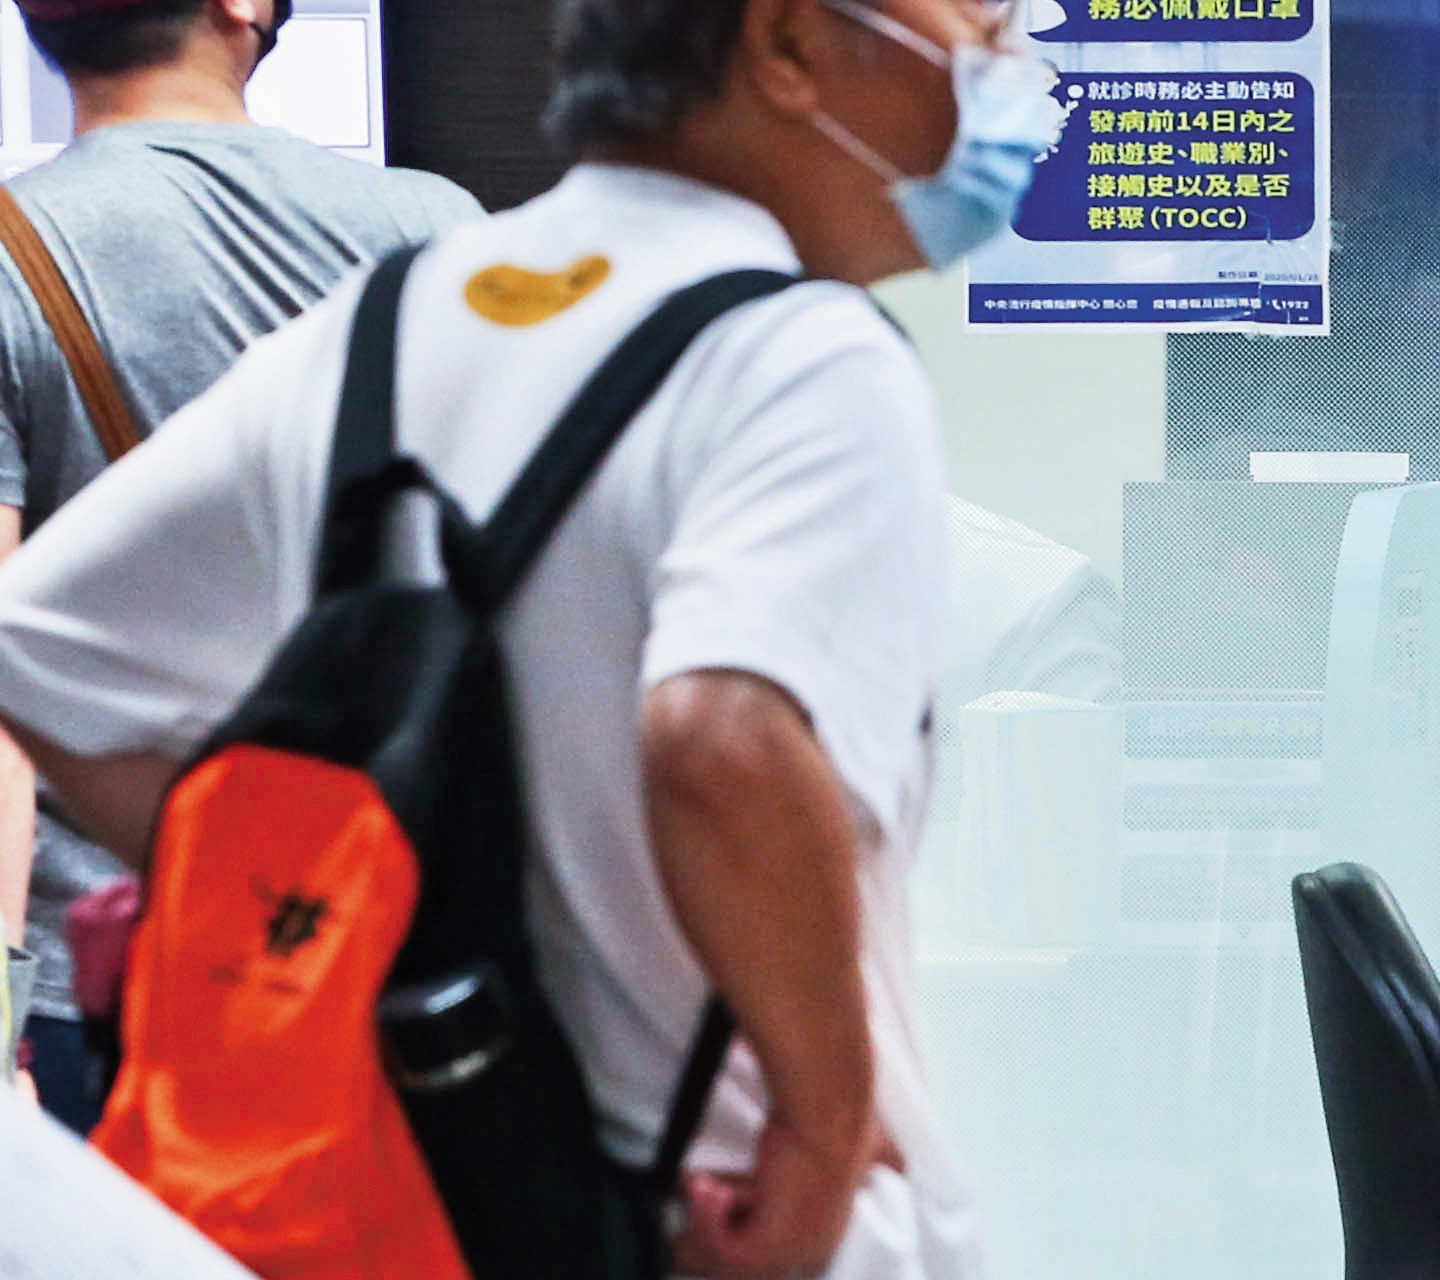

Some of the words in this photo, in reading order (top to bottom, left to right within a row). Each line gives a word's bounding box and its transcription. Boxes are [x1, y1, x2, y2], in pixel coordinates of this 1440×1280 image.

[1088, 80, 1295, 100] 就診時務必主動告知
[1089, 109, 1296, 133] 發病前14日內之
[1088, 173, 1290, 197] 接觸史以及是否
